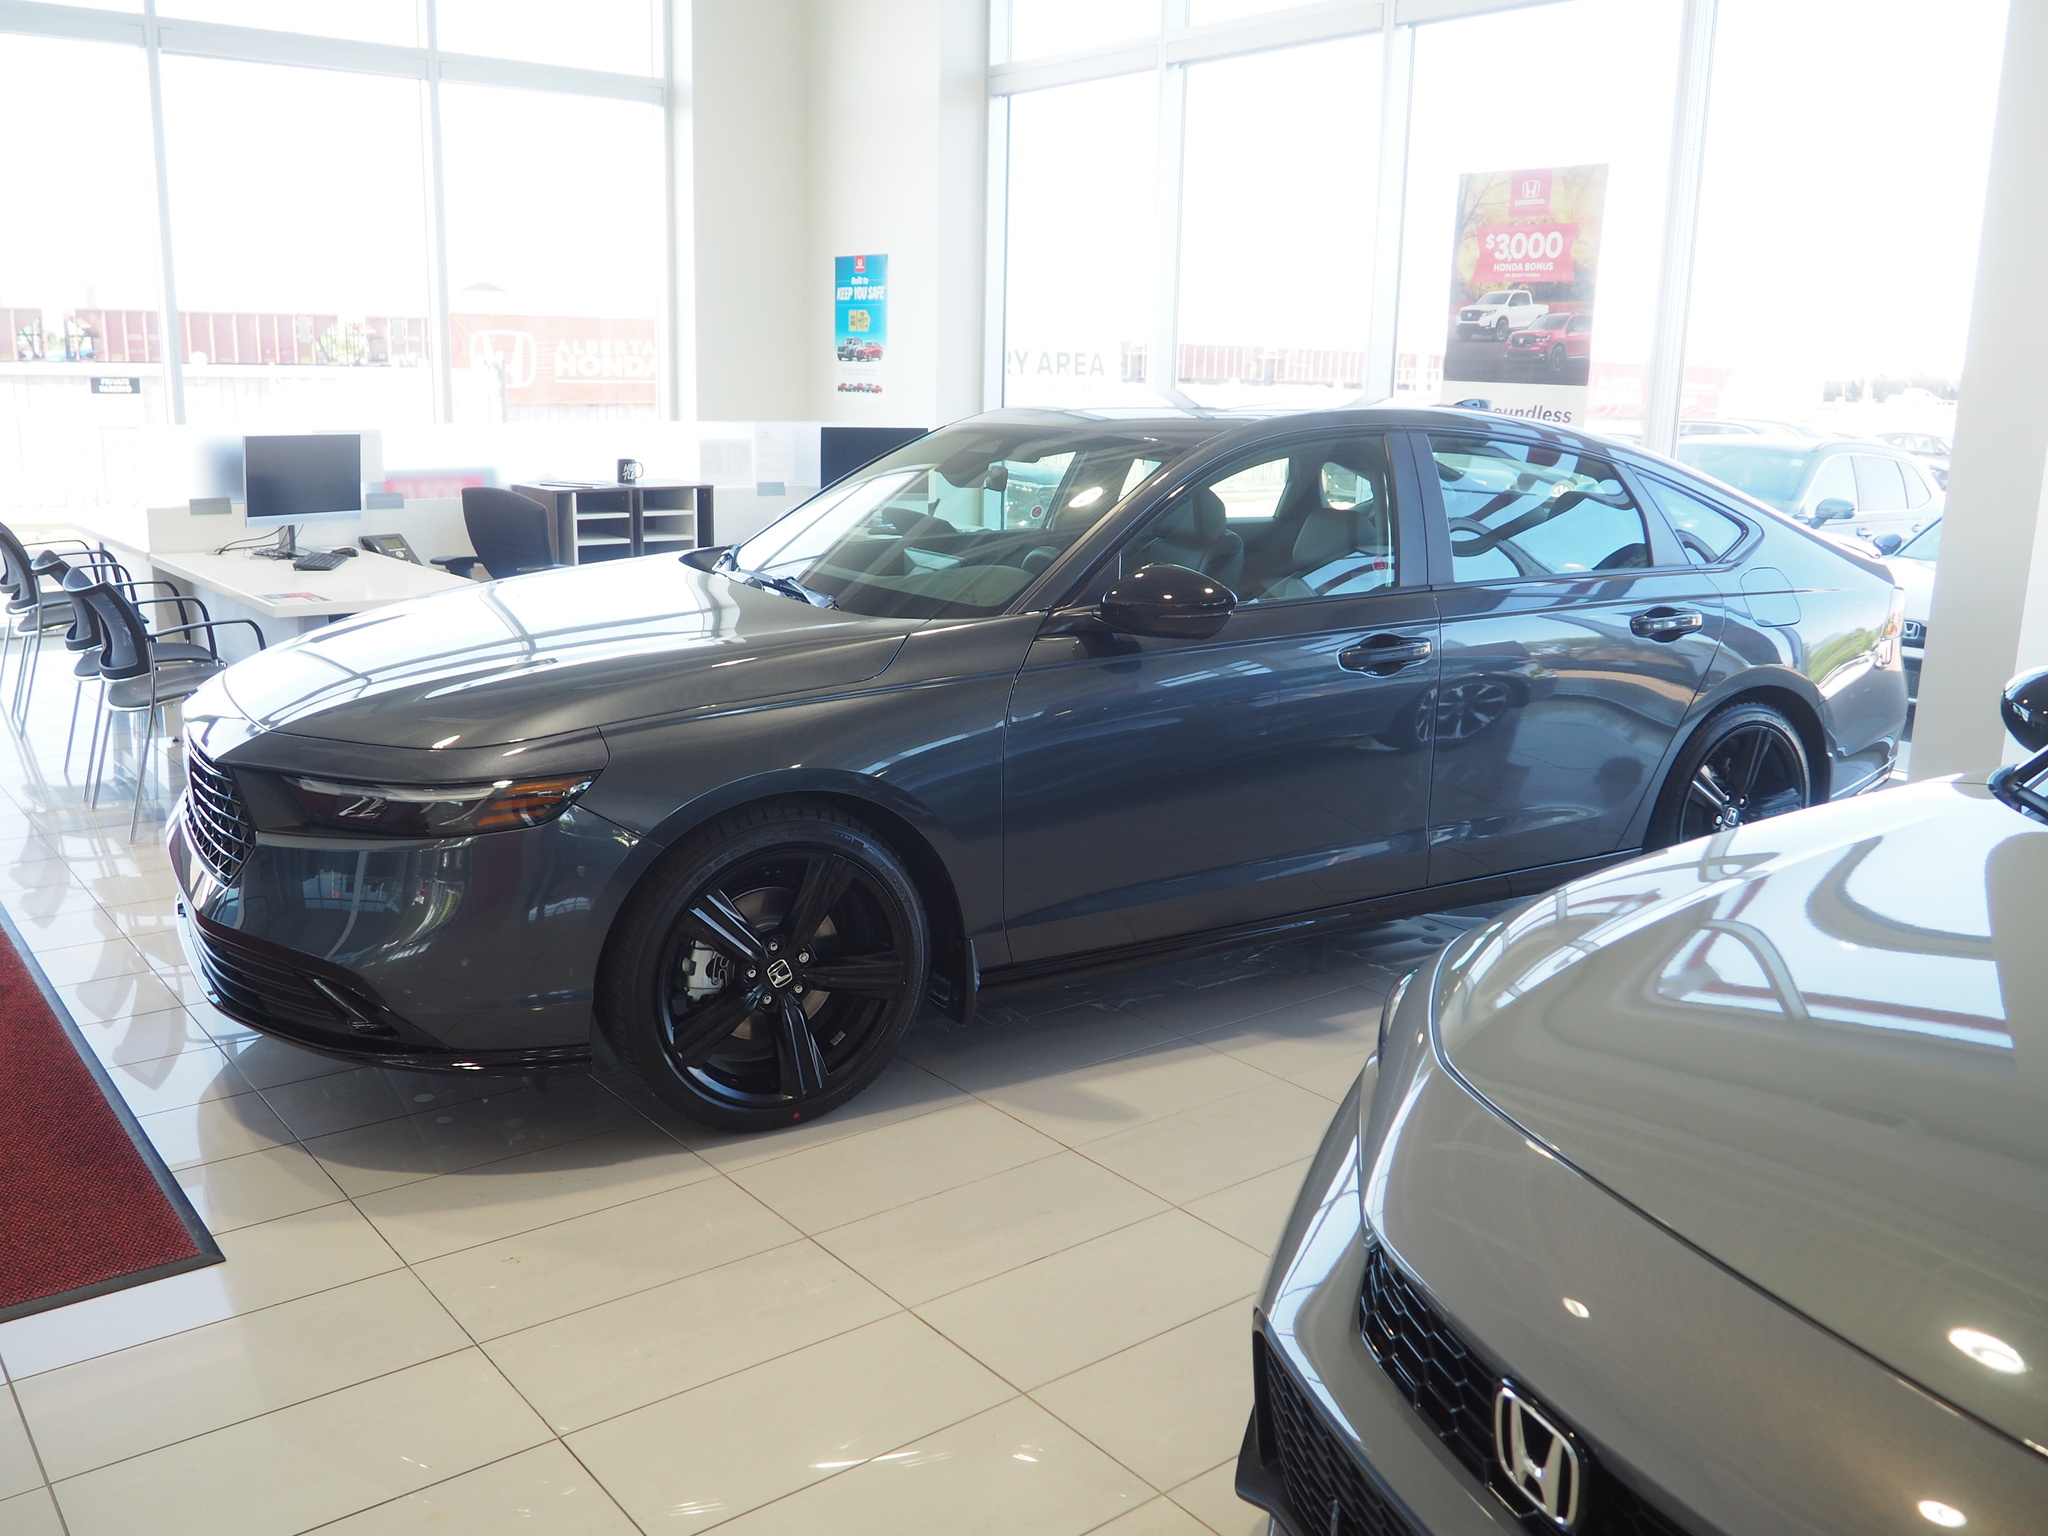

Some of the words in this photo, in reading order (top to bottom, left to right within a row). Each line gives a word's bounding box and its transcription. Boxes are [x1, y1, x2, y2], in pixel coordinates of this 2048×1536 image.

[1485, 231, 1564, 261] $3,000
[1493, 262, 1523, 272] HONDA
[1525, 262, 1554, 271] BONUS
[837, 286, 853, 300] KEEP
[853, 286, 868, 300] YOU
[867, 285, 885, 300] SAFE
[556, 339, 656, 355] ALBERTA
[1036, 351, 1105, 377] AREA
